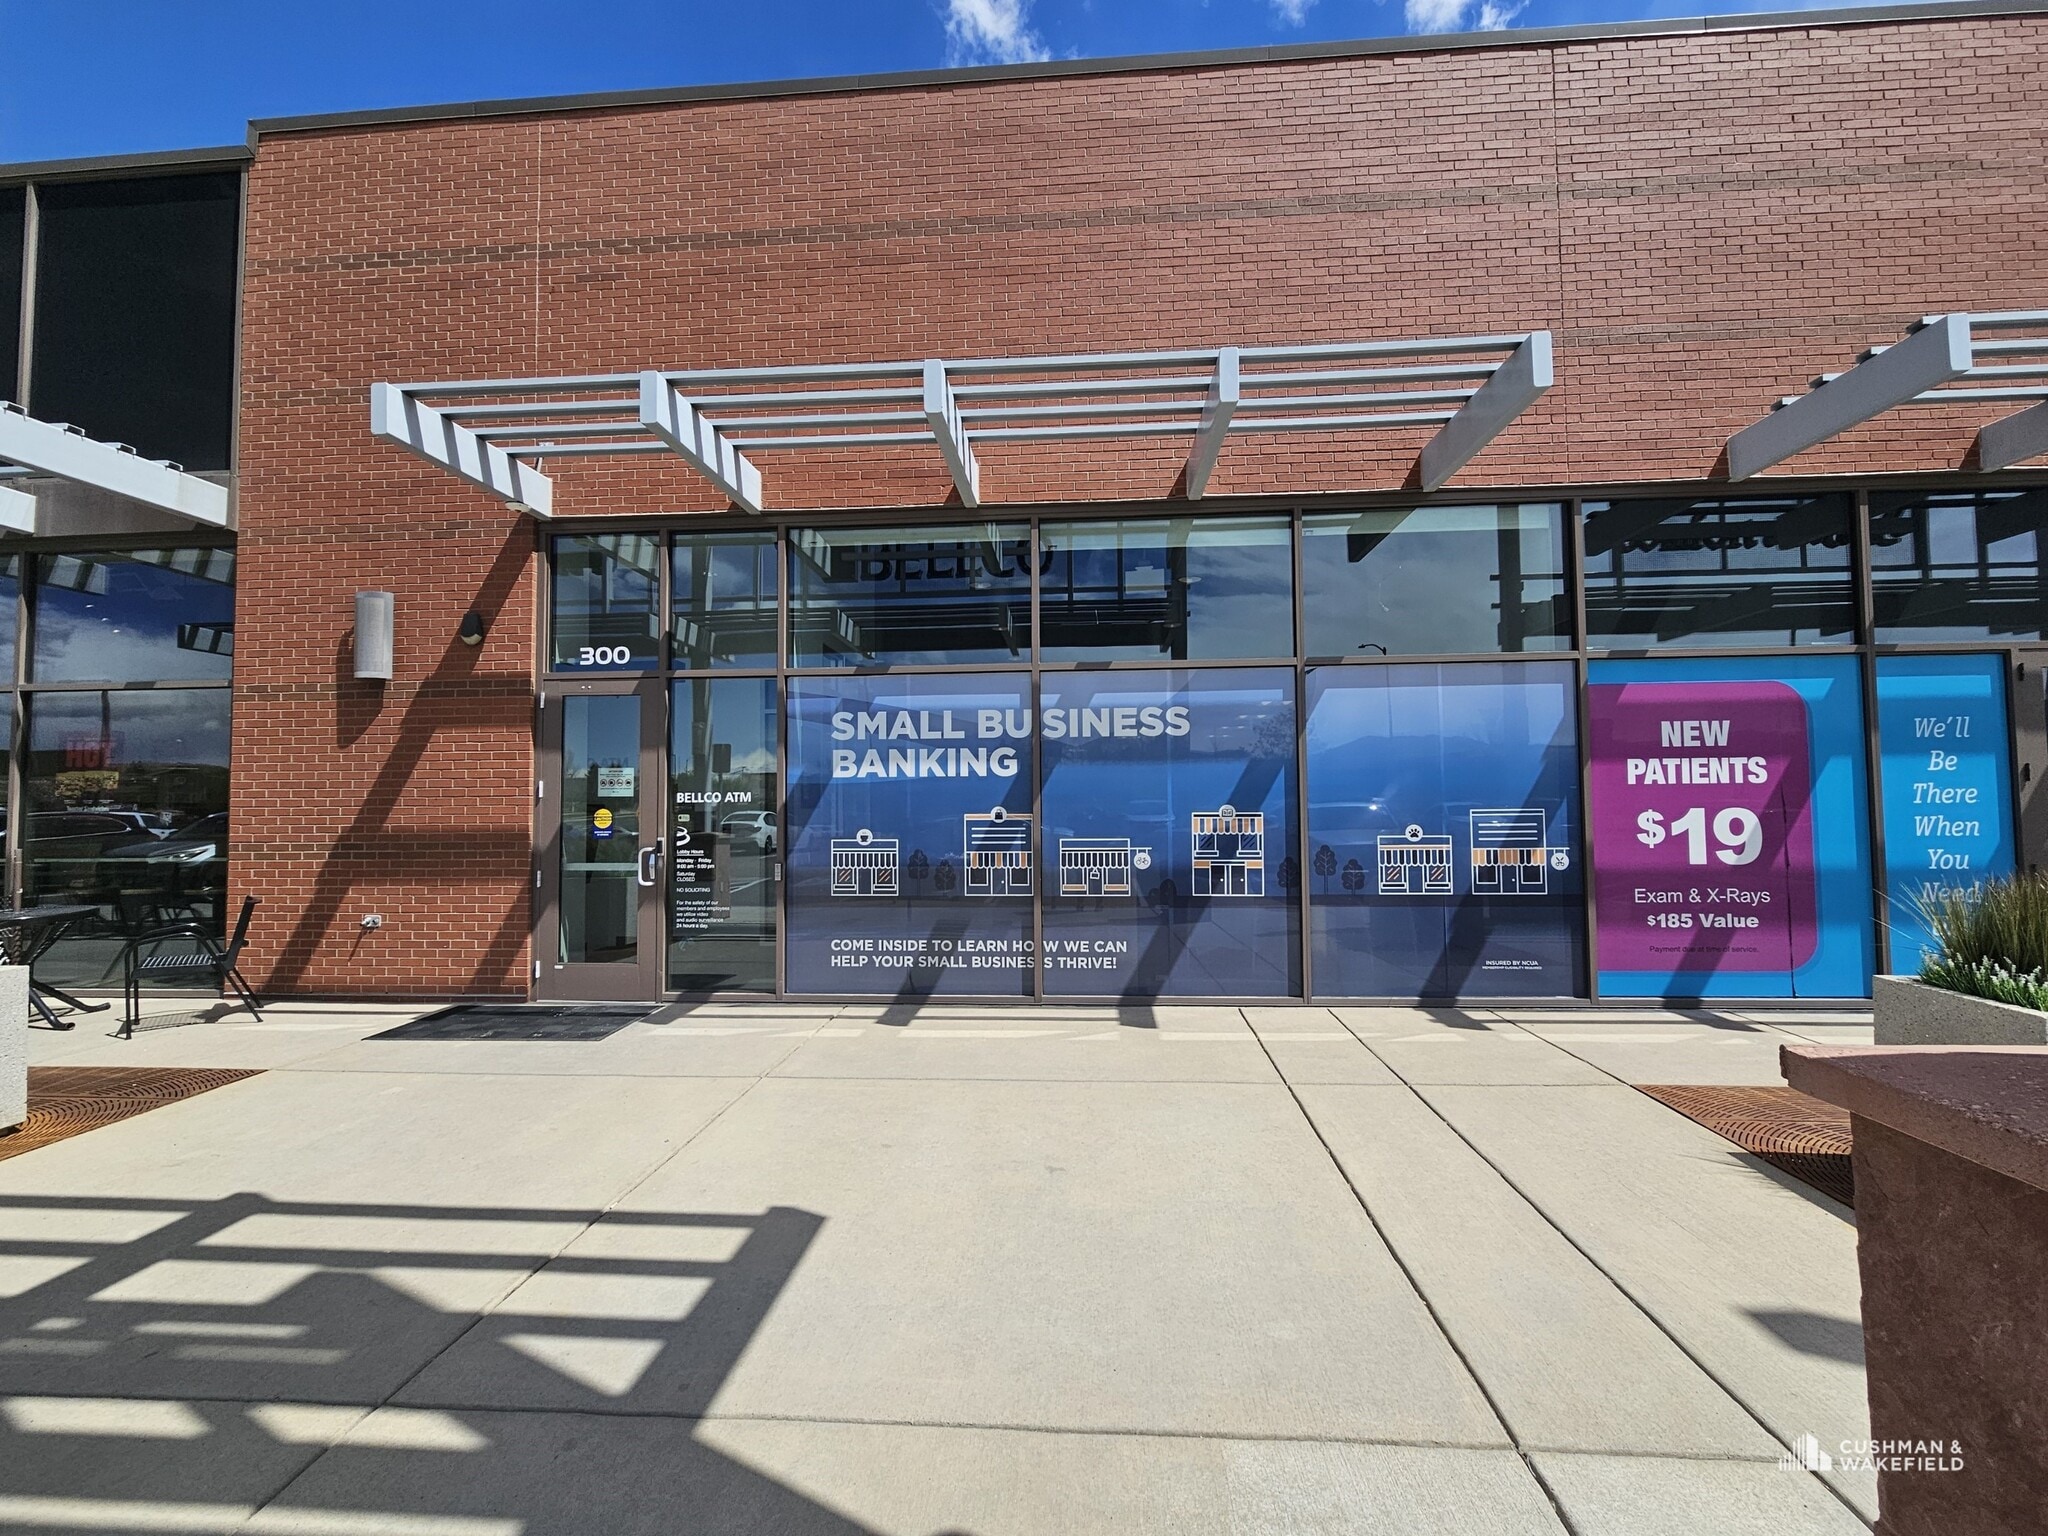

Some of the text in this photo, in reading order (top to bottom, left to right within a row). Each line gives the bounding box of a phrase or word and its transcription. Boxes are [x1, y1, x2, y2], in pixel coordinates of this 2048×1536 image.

[579, 646, 631, 666] 300
[831, 707, 1191, 741] SMALL BUSINESS
[1661, 720, 1730, 747] NEW
[1914, 716, 1970, 738] We'll
[832, 747, 1018, 778] BANKING
[1627, 756, 1768, 785] PATIENTS
[1928, 750, 1958, 771] Be
[676, 791, 752, 804] BELLCO ATM
[1913, 782, 1978, 804] There
[1637, 807, 1763, 866] $19
[1914, 815, 1980, 837] When
[1928, 849, 1970, 870] You
[1634, 888, 1771, 906] Exam & X-Rays
[1647, 913, 1759, 928] $185 Value
[831, 939, 1127, 953] COME INSIDE TO LEARN HOW WE CAN
[1649, 945, 1681, 954] Payment
[831, 955, 1117, 969] HELP YOUR SMALL BUSINESS THRIVE!
